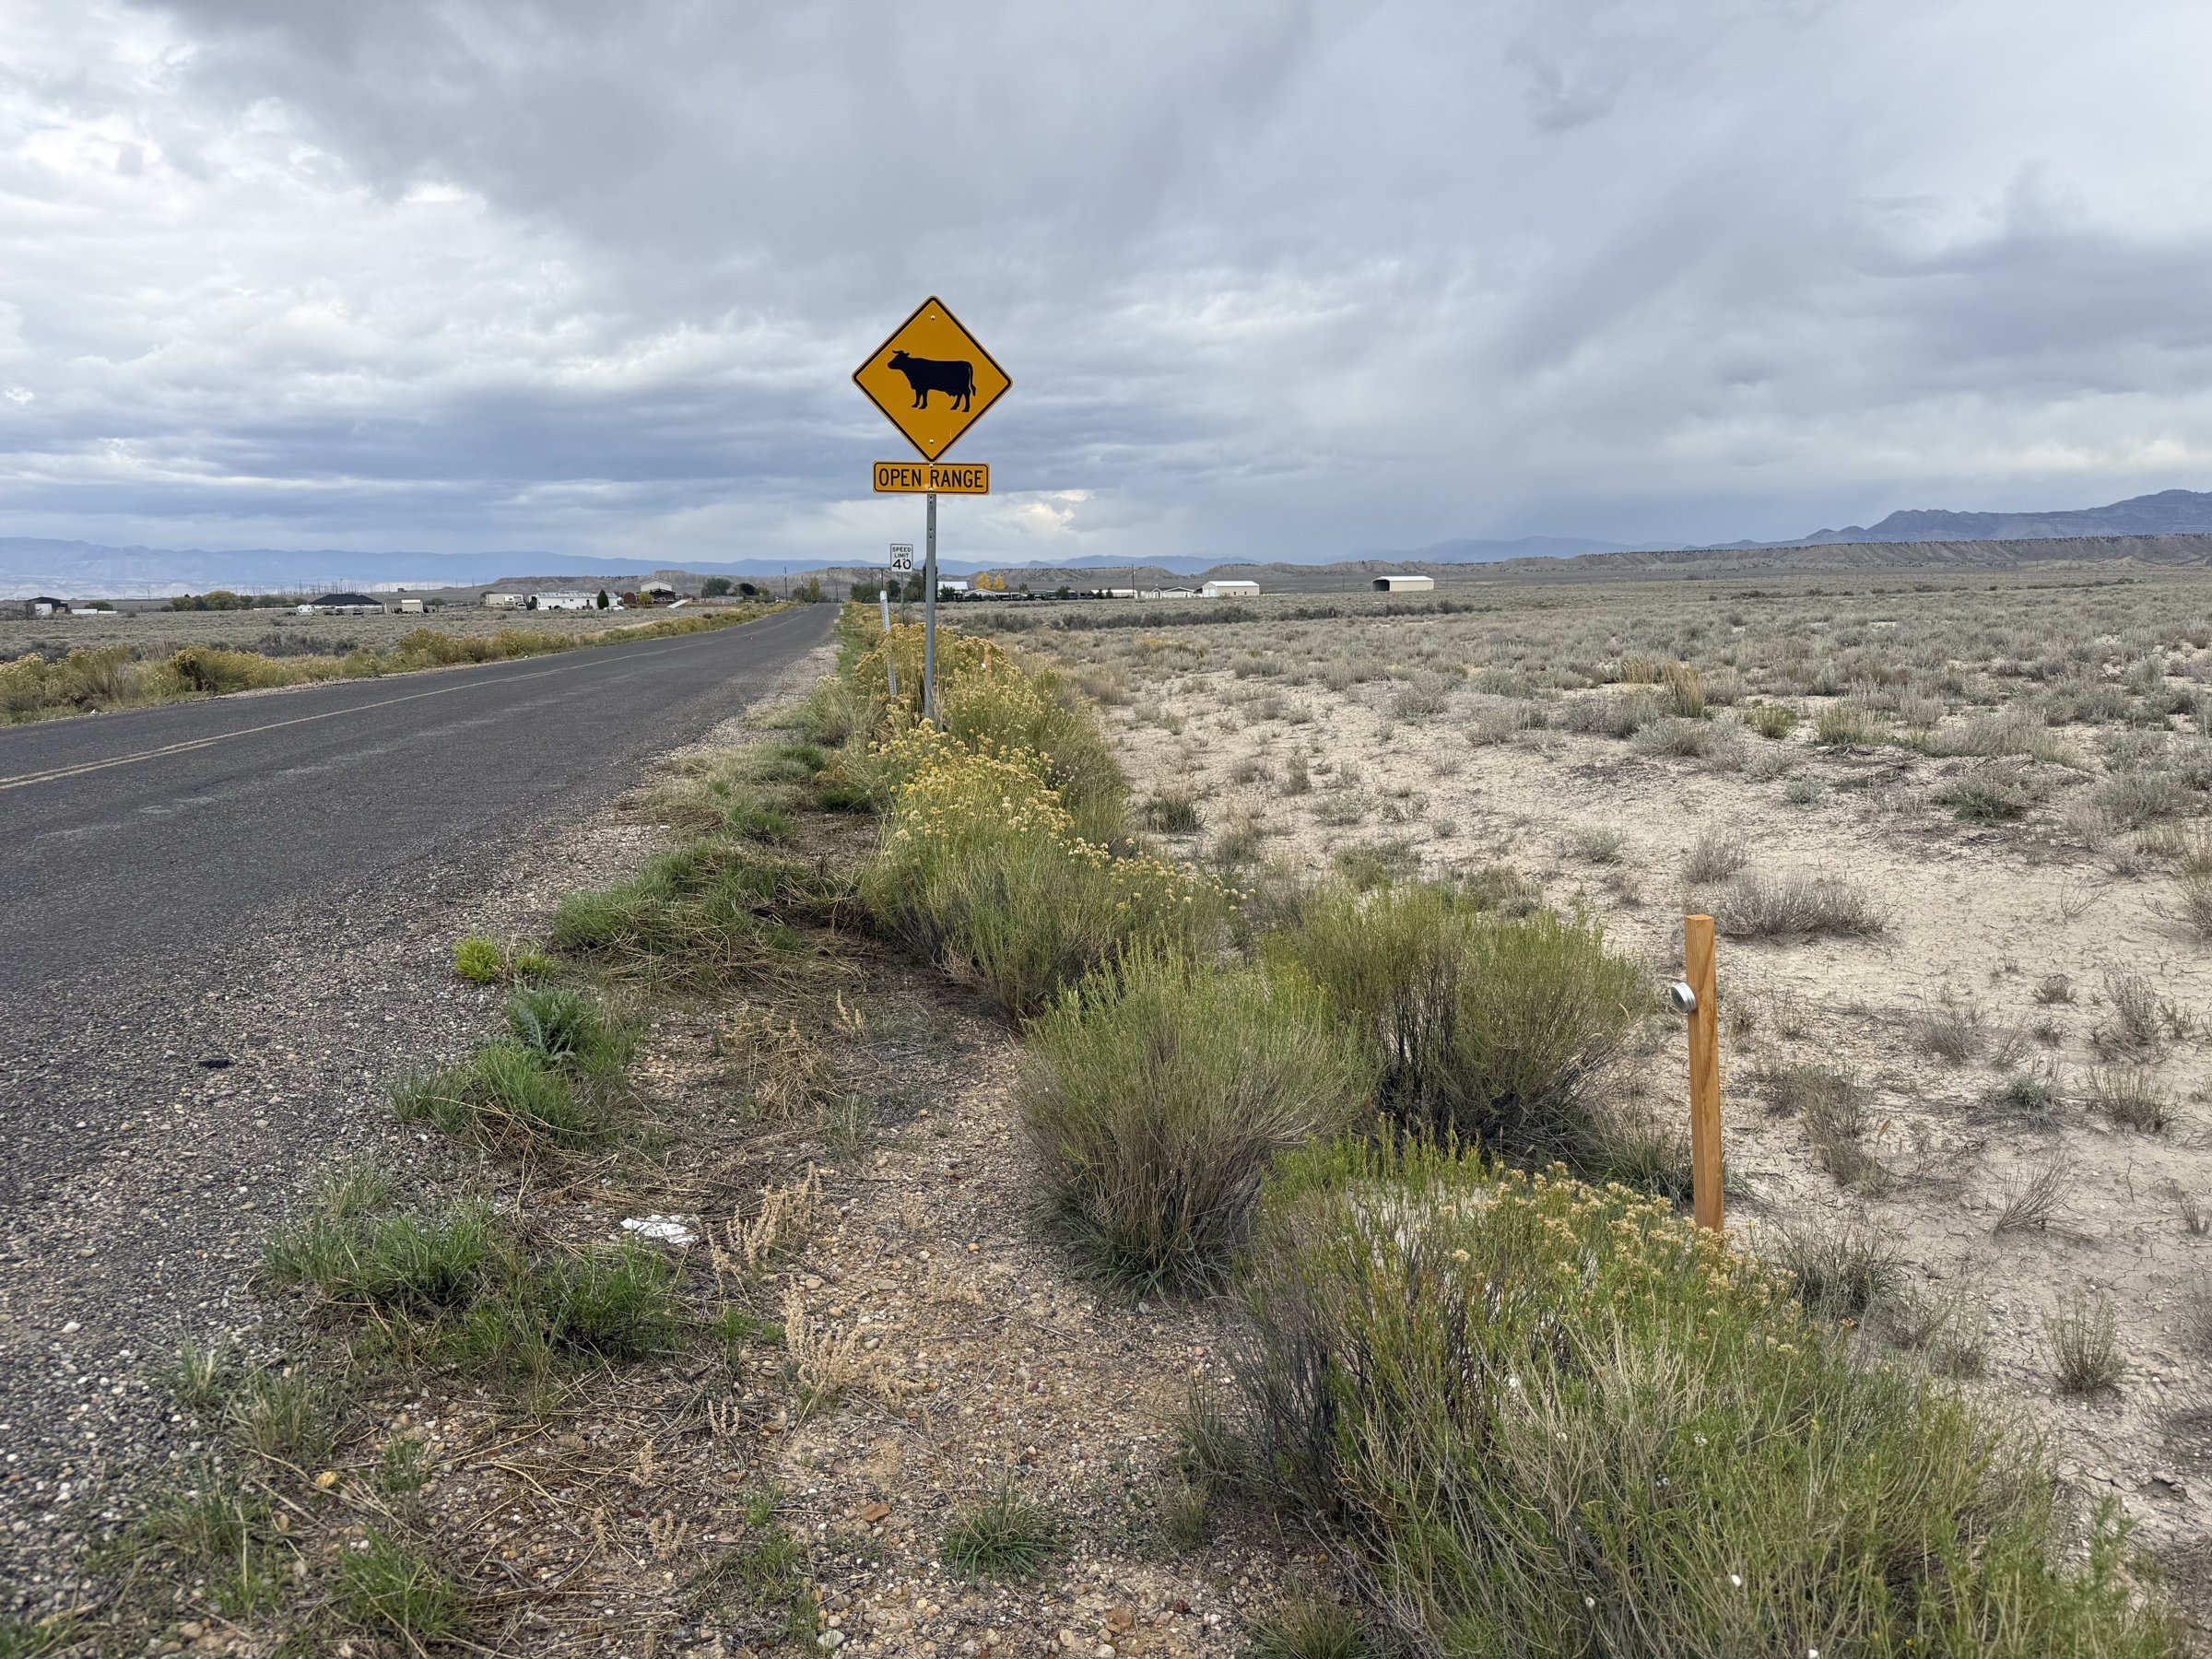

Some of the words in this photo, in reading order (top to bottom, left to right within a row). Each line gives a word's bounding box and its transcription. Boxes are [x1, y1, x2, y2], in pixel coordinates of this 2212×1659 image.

[878, 468, 922, 487] OPEN
[930, 469, 983, 488] RANGE
[892, 559, 912, 570] 40
